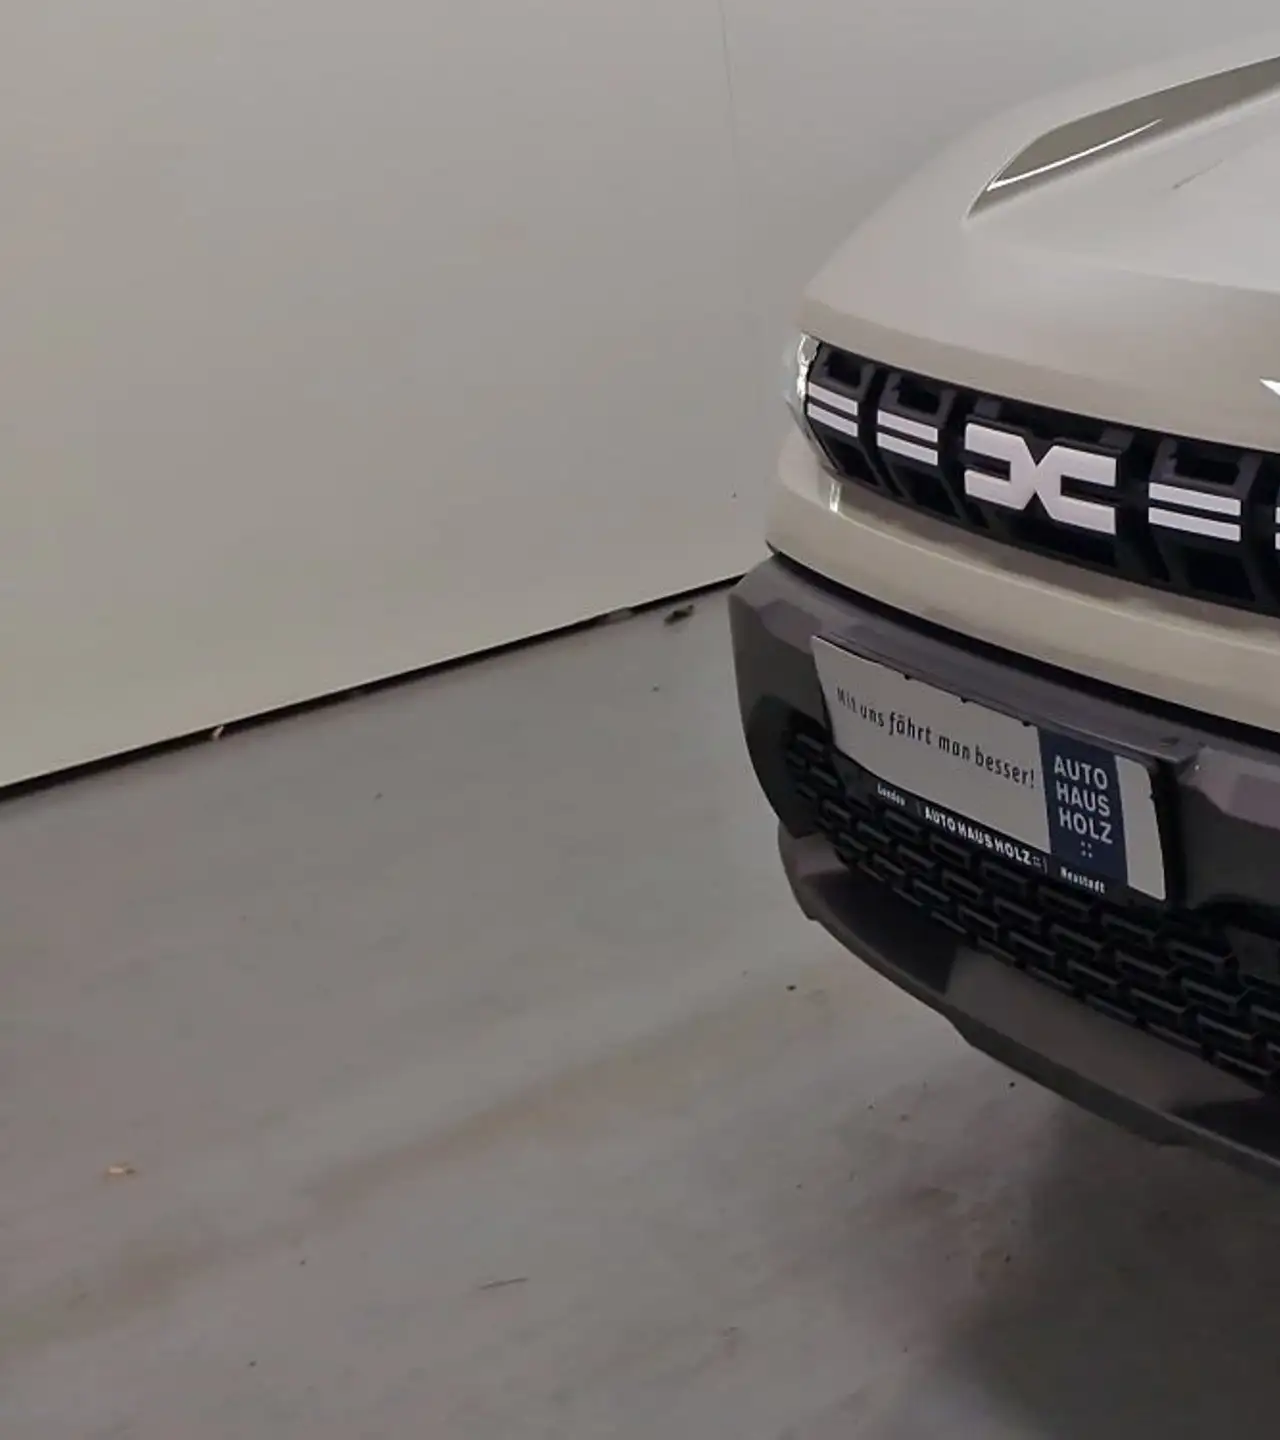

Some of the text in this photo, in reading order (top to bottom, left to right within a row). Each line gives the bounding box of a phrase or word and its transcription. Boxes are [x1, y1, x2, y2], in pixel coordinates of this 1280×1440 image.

[837, 686, 1034, 789] Mit uns fährt man besser!
[1053, 754, 1108, 790] AUTO
[1055, 776, 1111, 817] HAUS
[1057, 806, 1114, 844] HOLZ
